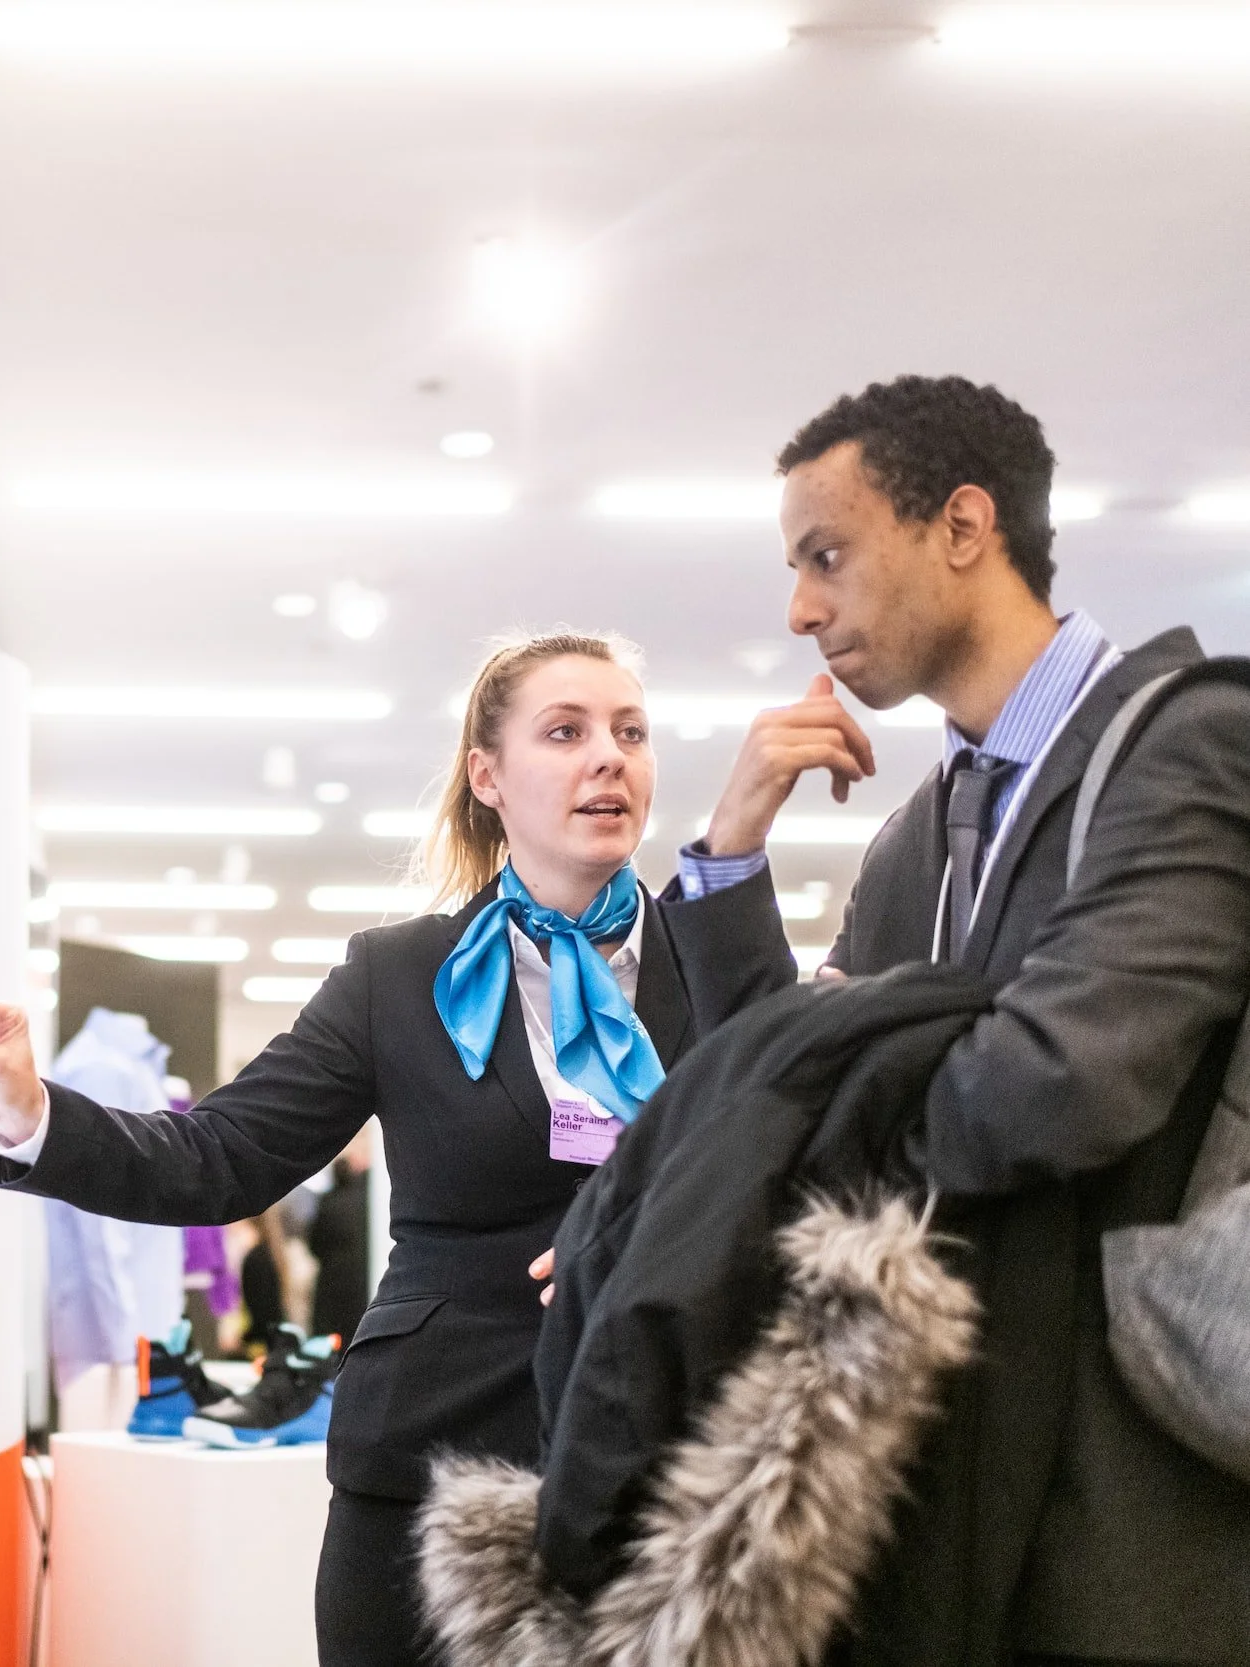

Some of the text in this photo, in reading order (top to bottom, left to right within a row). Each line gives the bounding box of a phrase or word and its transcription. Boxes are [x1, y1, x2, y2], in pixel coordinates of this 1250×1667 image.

[552, 1119, 582, 1131] Keller
[554, 1111, 609, 1126] Lea Seraina
